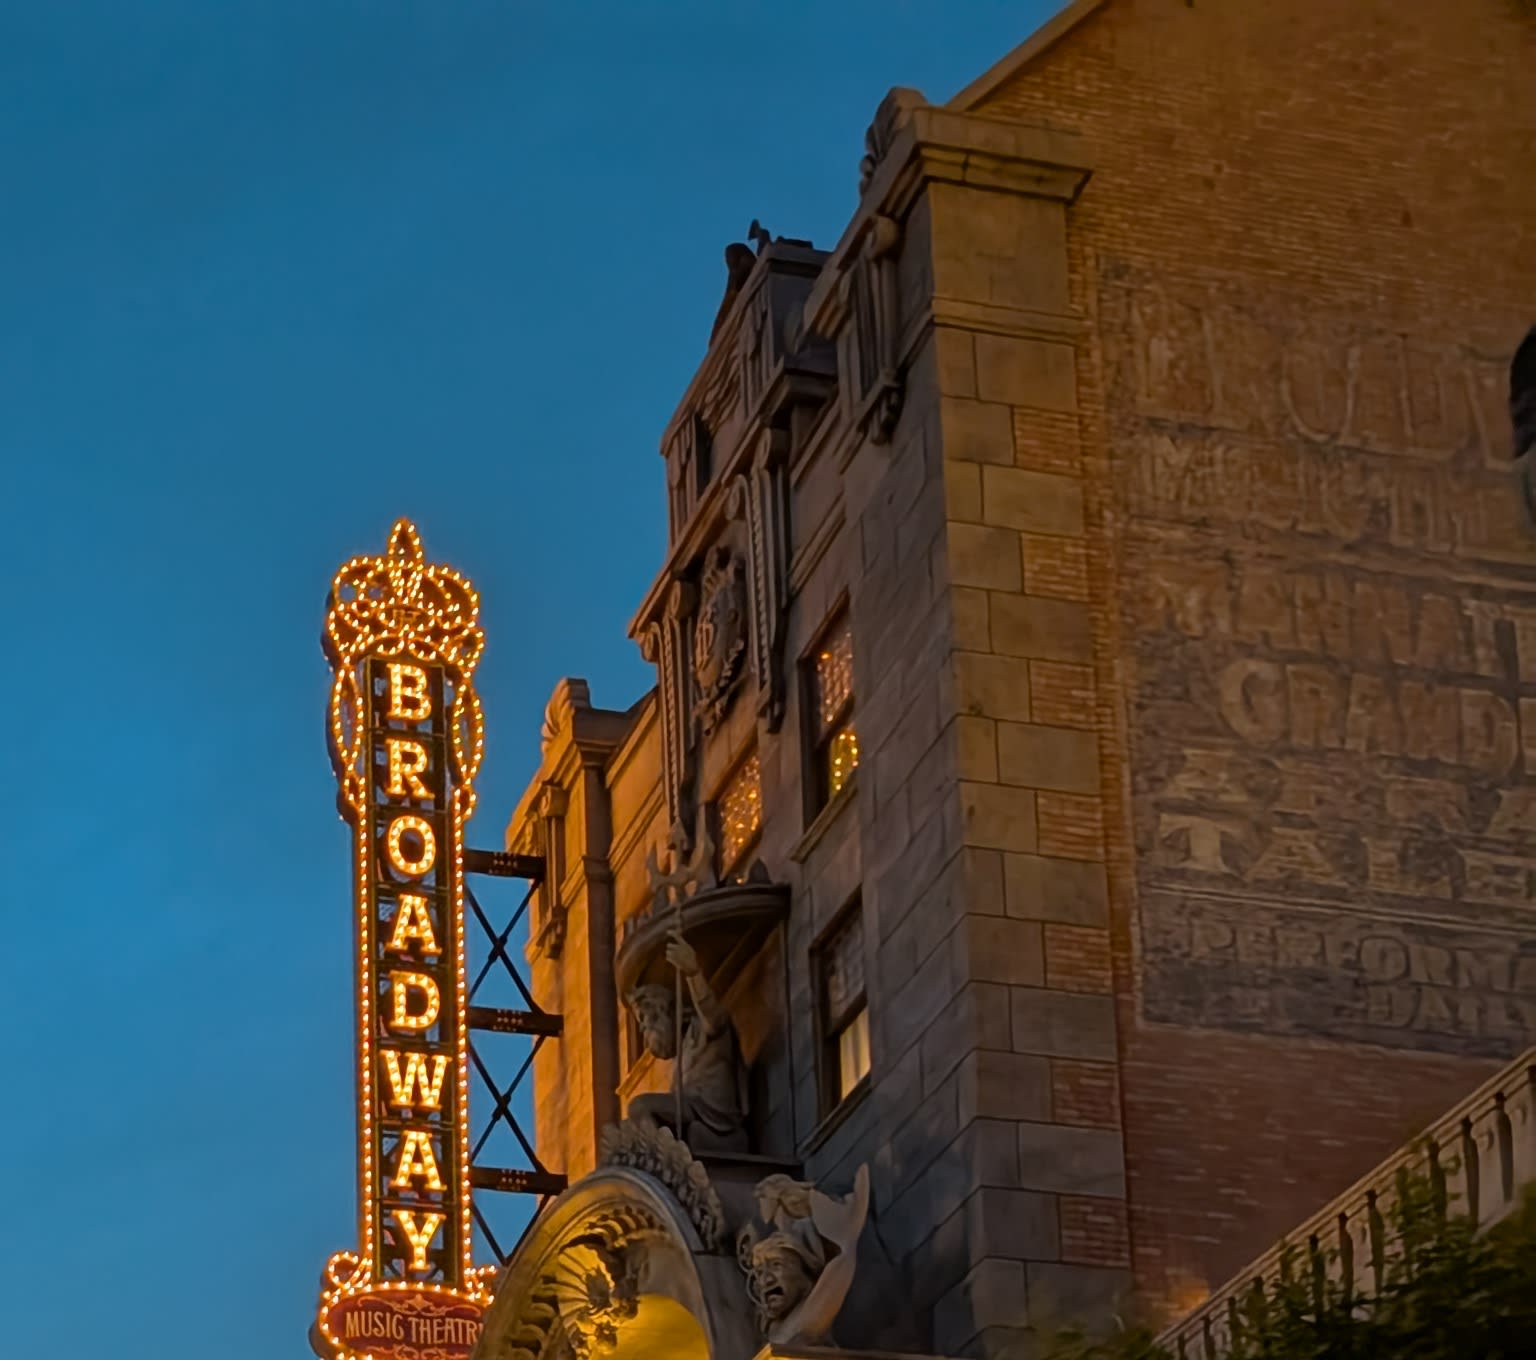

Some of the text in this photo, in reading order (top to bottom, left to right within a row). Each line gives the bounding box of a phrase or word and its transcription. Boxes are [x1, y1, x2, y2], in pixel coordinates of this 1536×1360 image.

[1219, 658, 1536, 772] GRAND
[383, 662, 451, 1272] BROADWAY
[345, 1310, 484, 1346] MUSIC THEATR
